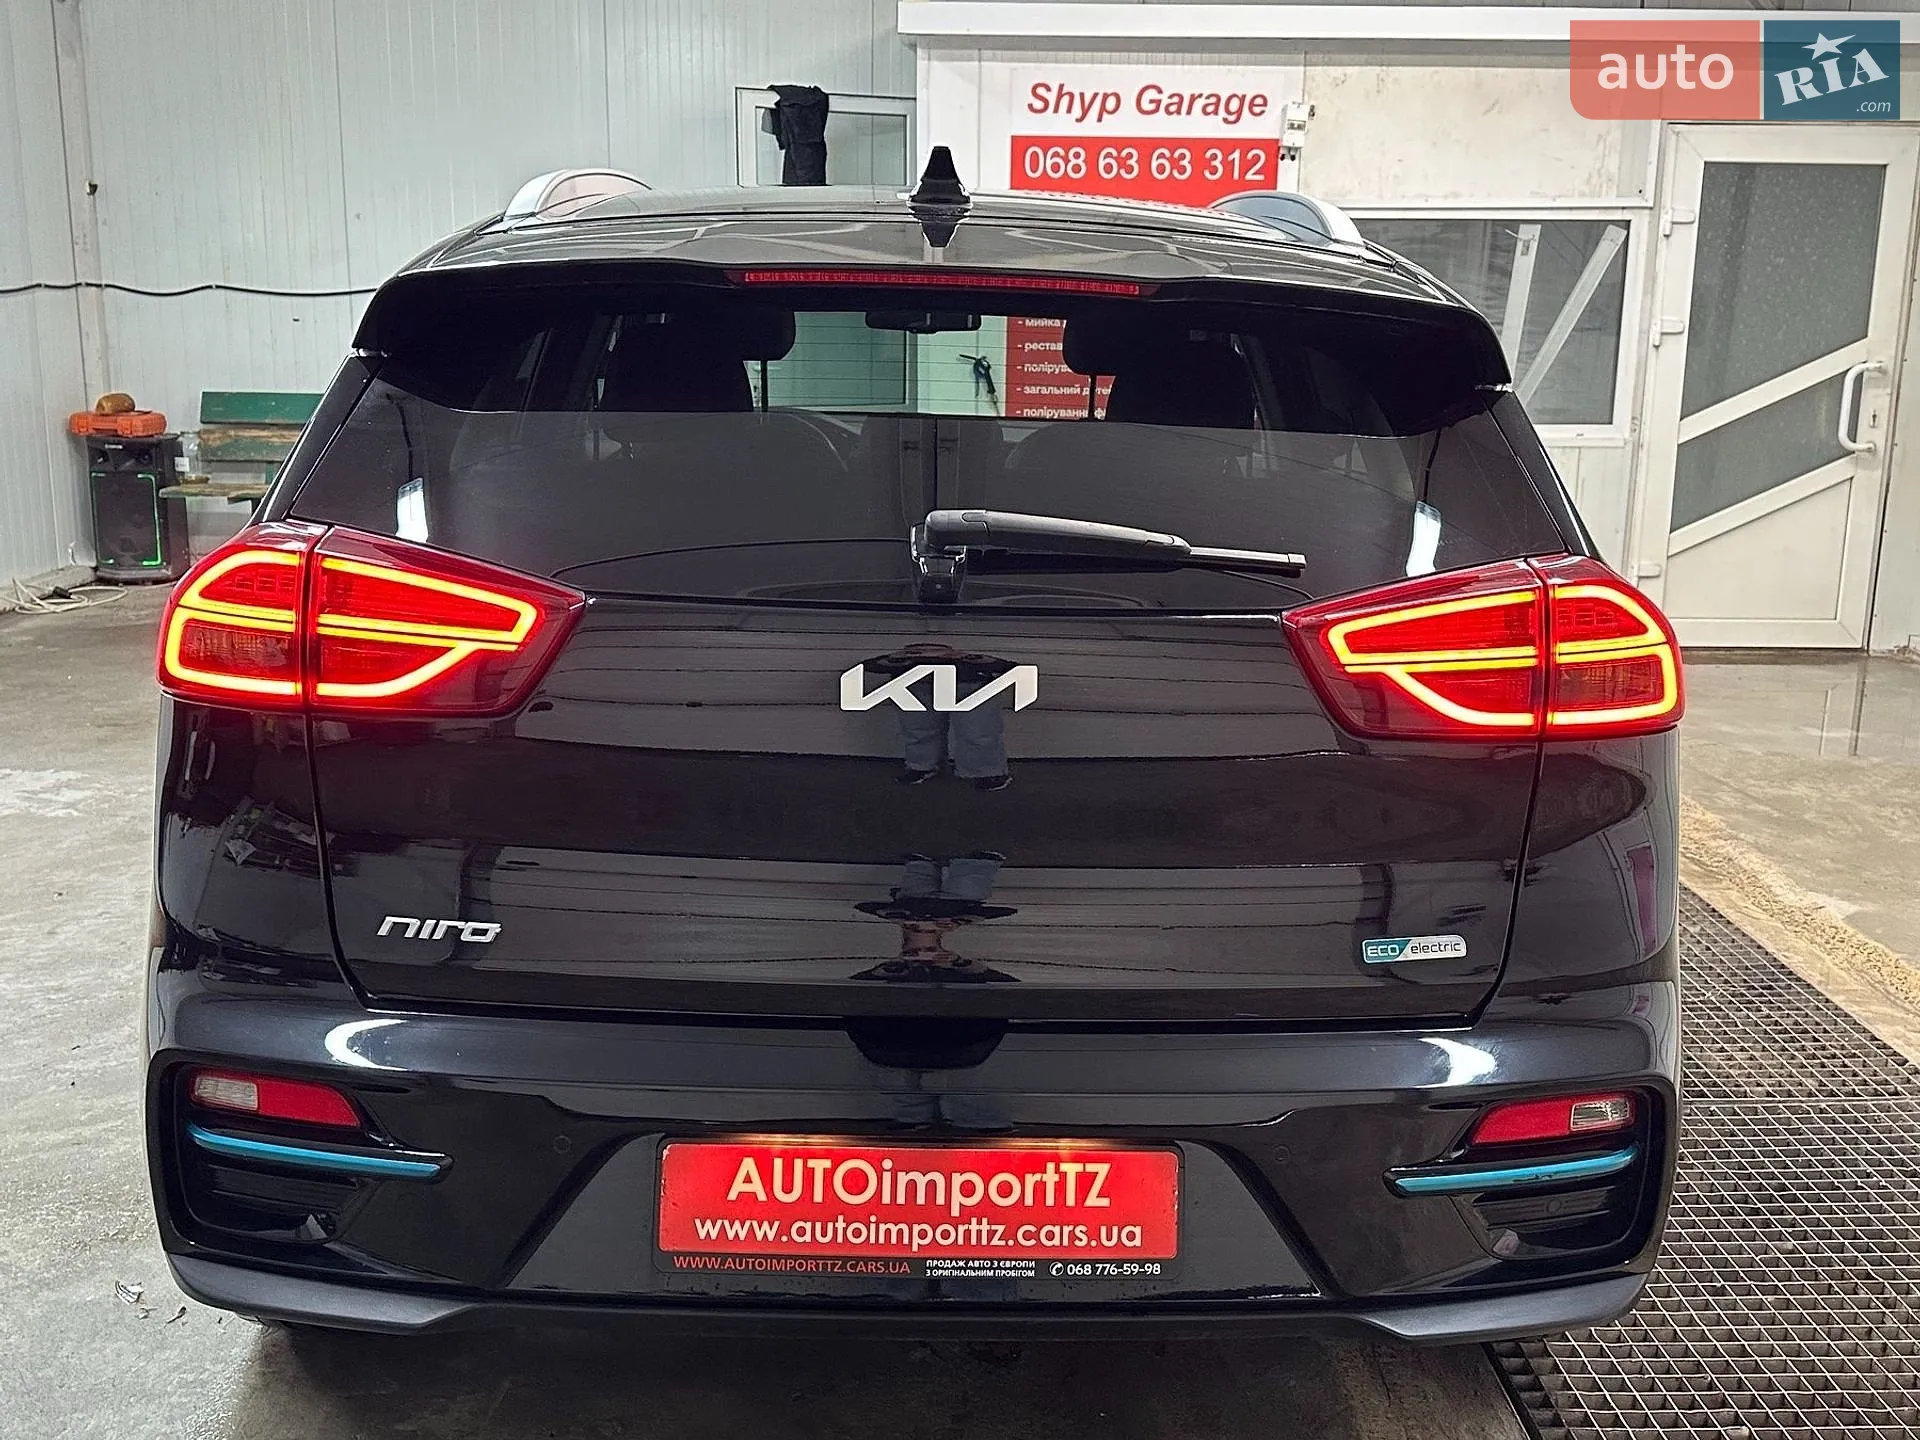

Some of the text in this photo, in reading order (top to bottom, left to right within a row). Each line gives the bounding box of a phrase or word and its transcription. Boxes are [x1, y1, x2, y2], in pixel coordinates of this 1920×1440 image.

[1027, 82, 1269, 125] Shyp Garage
[1023, 146, 1266, 182] 068 63 63 312
[1023, 384, 1081, 396] загальний
[840, 663, 1039, 712] KIA
[376, 915, 502, 943] niro
[1367, 941, 1462, 957] ECO electric
[727, 1156, 1112, 1218] AUTOimportTZ
[694, 1214, 1143, 1253] www.autoimporttz.cars.ua
[673, 1255, 912, 1275] WWW.AUTOIMPORTTZ.CARS.UA
[926, 1260, 966, 1269] ПРОДАЖ
[967, 1260, 991, 1268] АВТО
[999, 1260, 1036, 1268] ЄВРОПИ
[1066, 1262, 1161, 1276] 068 776-59-98
